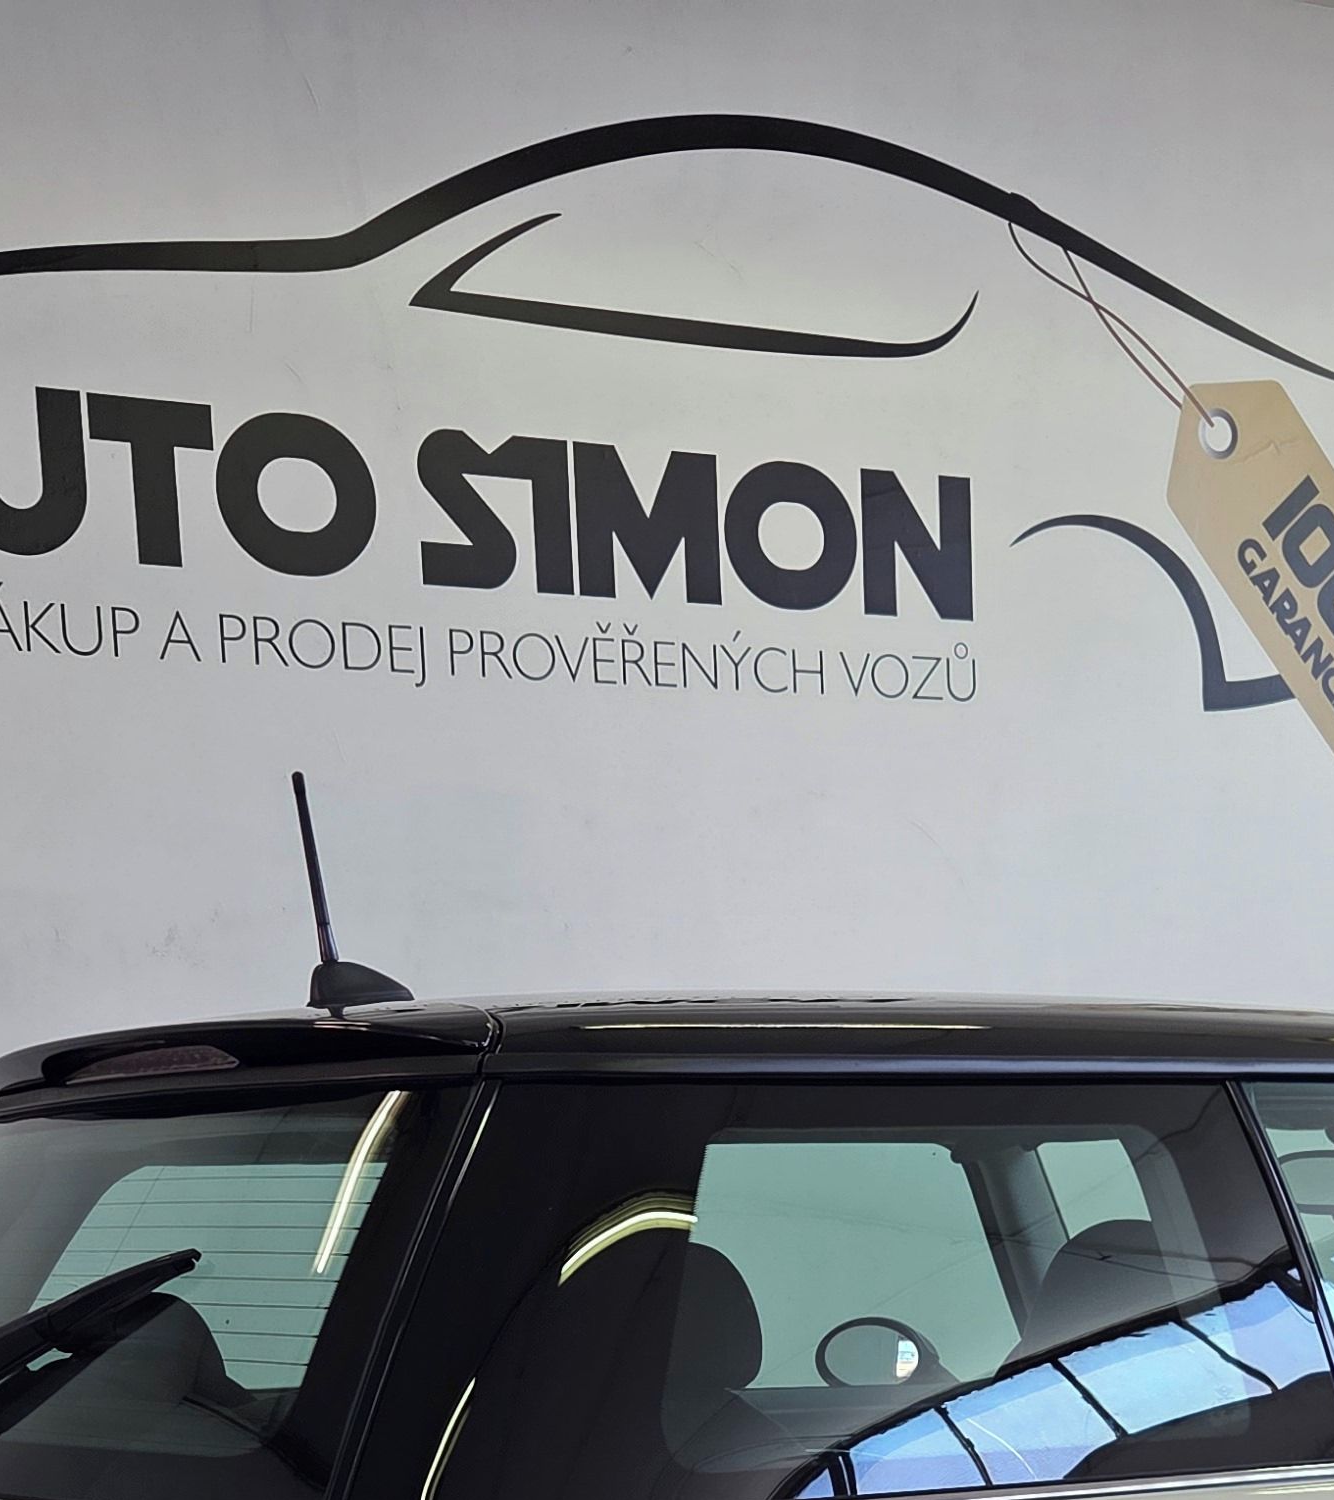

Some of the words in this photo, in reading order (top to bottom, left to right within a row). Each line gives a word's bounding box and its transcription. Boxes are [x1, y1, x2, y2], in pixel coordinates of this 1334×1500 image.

[416, 428, 975, 623] SIMON
[159, 609, 203, 663] A
[218, 612, 427, 689] PRODEJ
[448, 620, 825, 696] PROVĚŘENÝCH
[838, 641, 977, 703] VOZŮ
